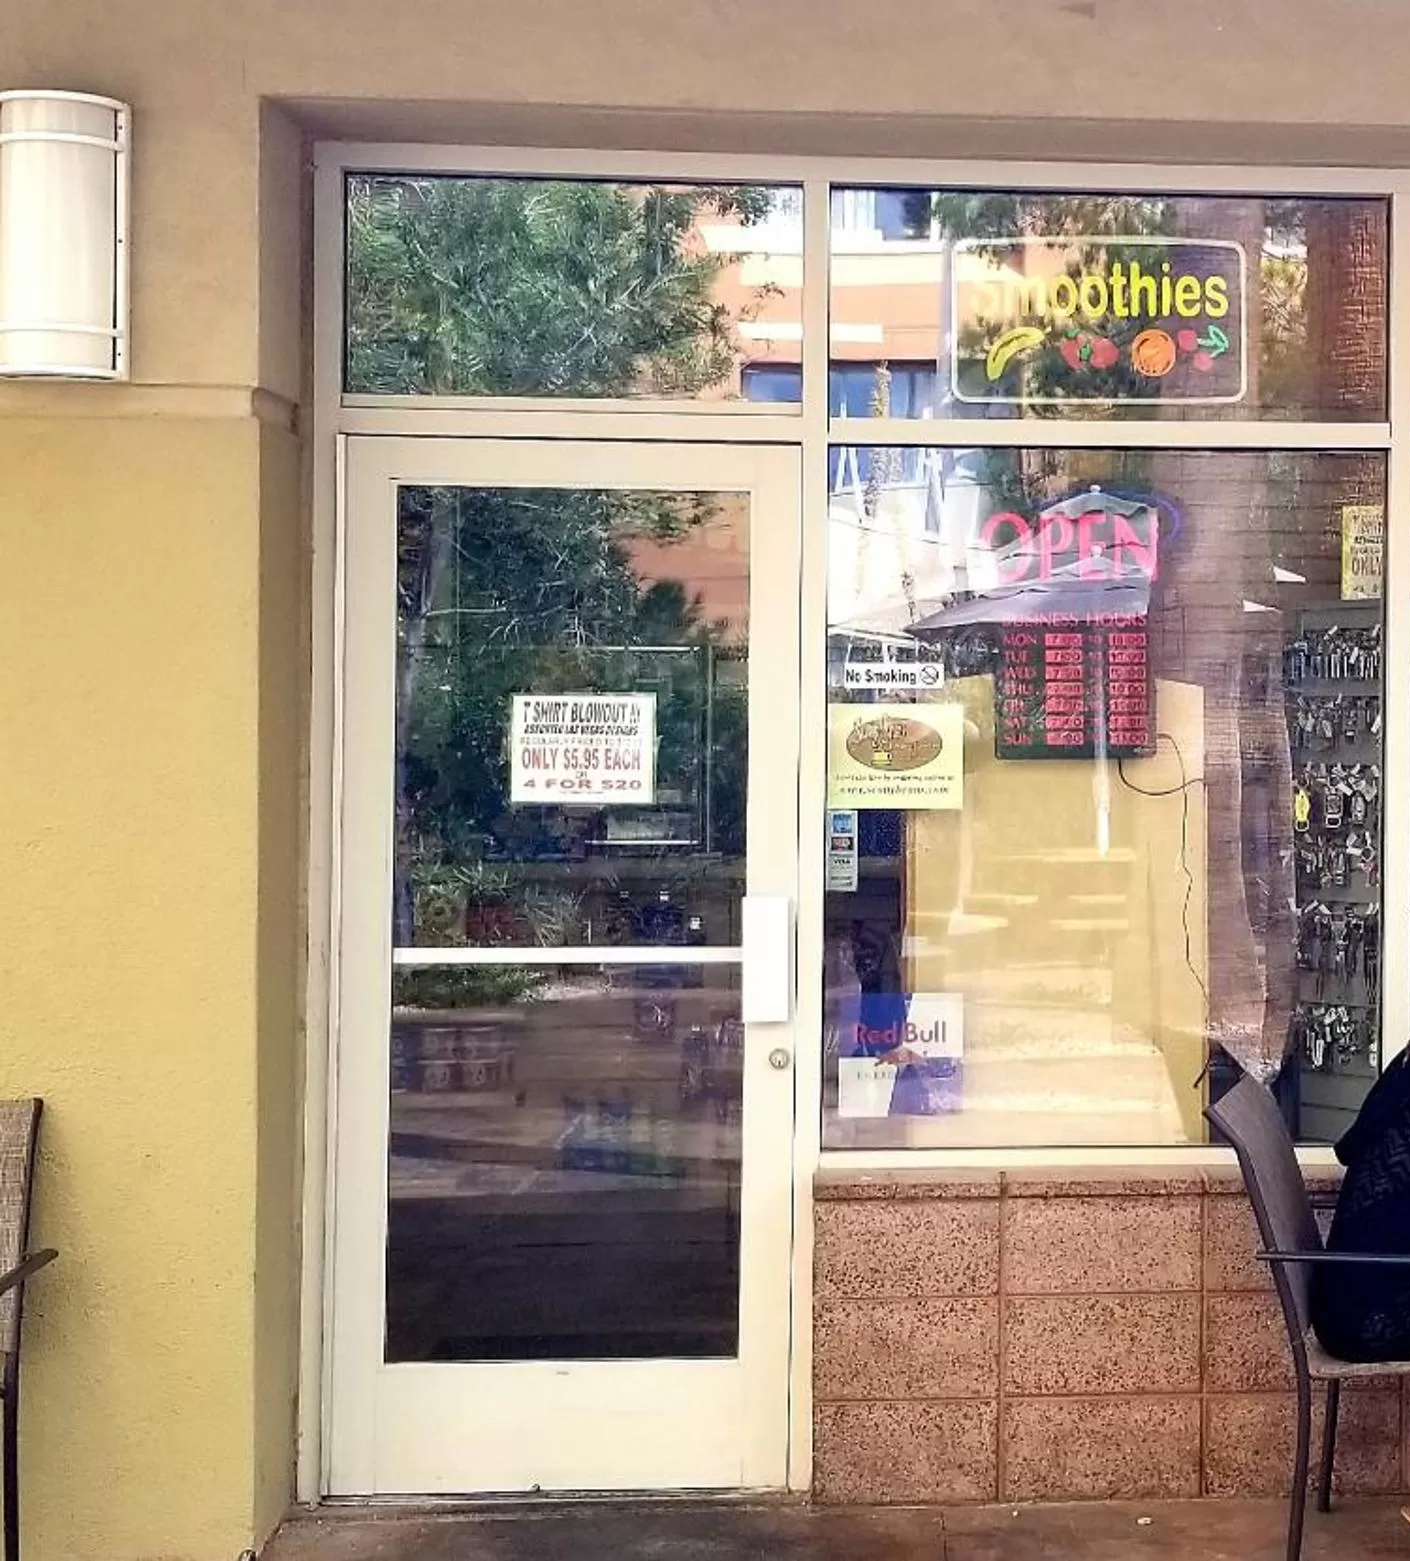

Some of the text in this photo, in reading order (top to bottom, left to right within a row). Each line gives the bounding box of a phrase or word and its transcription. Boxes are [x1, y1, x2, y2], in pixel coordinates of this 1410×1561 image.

[971, 262, 1229, 317] Smoothies
[982, 512, 1158, 583] OPEN
[1086, 612, 1146, 627] HOURS
[846, 669, 917, 685] No Smoking
[524, 701, 531, 723] T
[532, 701, 569, 723] SHIRT
[571, 702, 628, 723] BLOWOUT
[521, 748, 641, 770] ONLY $5.95 EACH
[523, 779, 536, 788] 4
[545, 779, 592, 789] FOR
[855, 1020, 946, 1044] Red Bull
